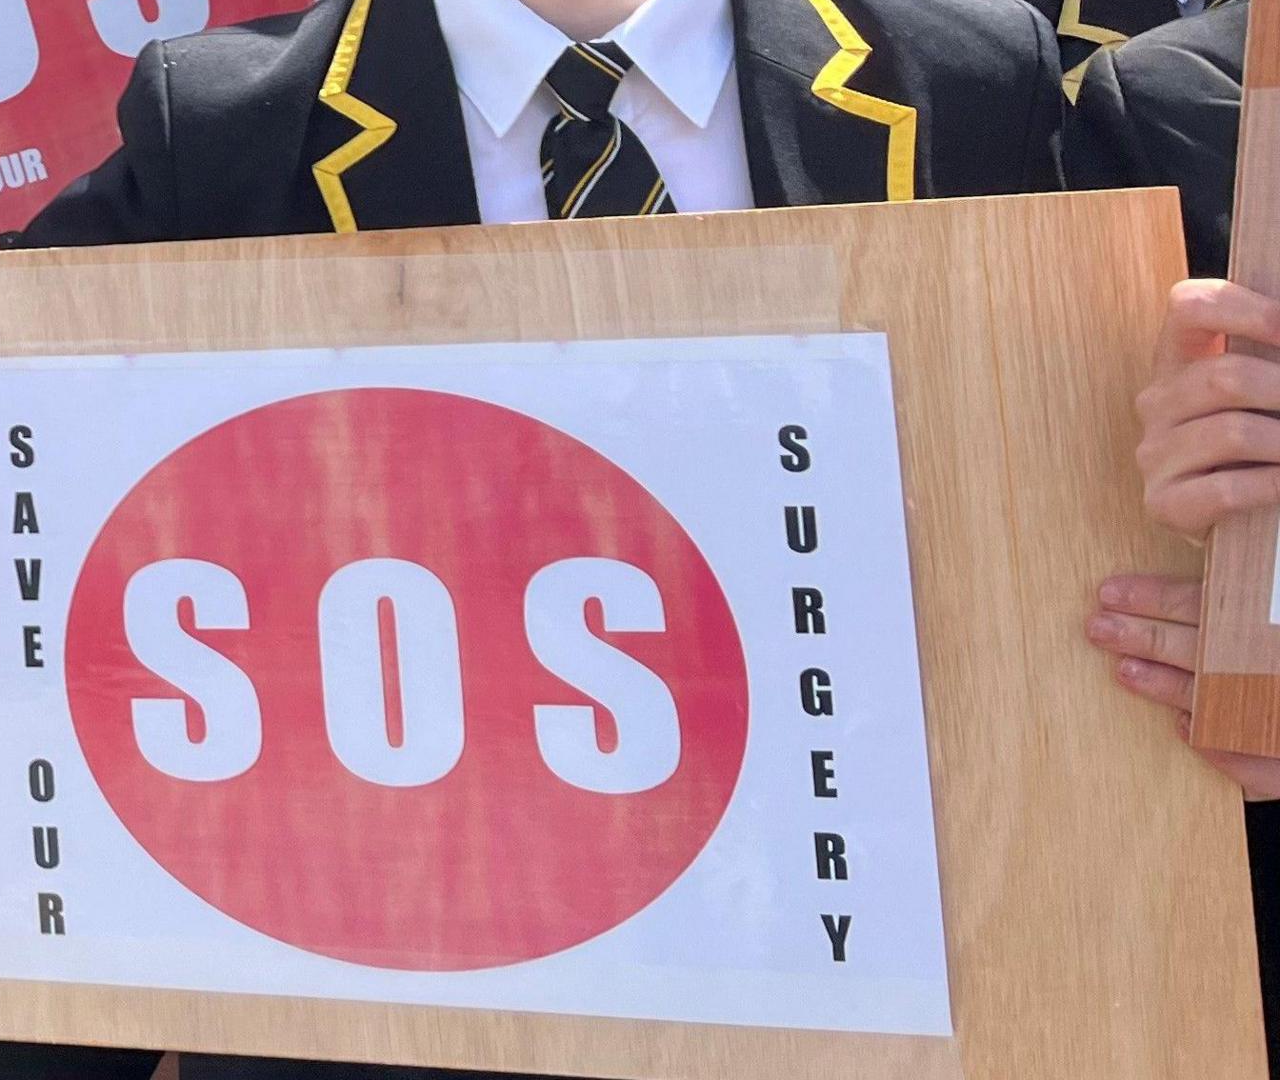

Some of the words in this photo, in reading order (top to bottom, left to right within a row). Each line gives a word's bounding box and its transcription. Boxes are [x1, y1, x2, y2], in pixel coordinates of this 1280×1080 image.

[9, 424, 45, 669] SAVE
[28, 758, 66, 936] OUR
[122, 557, 682, 795] SOS
[779, 424, 852, 964] SURGERY
